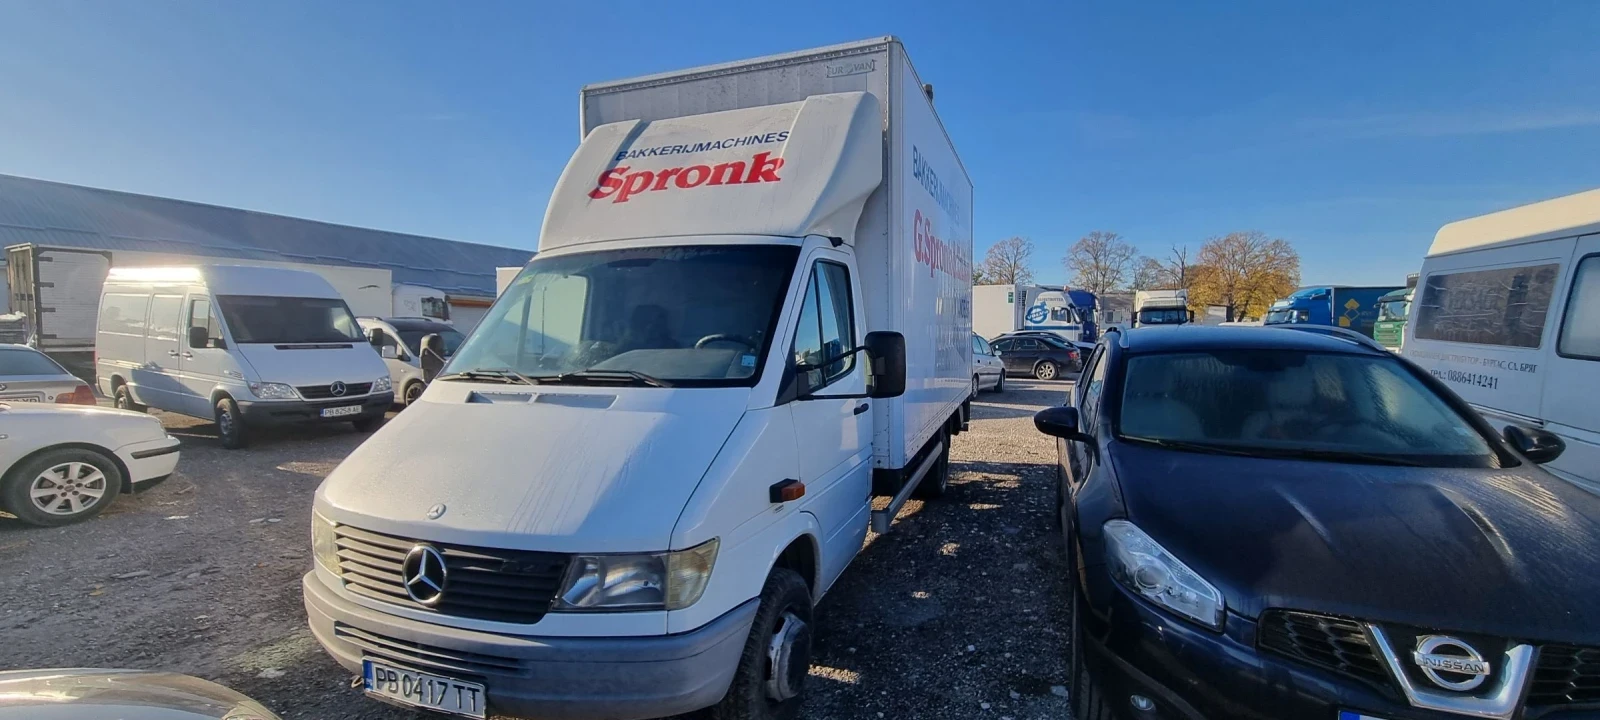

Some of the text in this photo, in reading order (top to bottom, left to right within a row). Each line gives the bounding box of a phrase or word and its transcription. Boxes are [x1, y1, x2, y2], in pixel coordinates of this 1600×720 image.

[615, 131, 789, 161] BAKKERIJMACHINES
[588, 151, 785, 204] Spronk
[1447, 369, 1498, 390] 0886414241
[1423, 656, 1485, 673] NISSAN
[374, 666, 480, 712] PB 0417 TT
